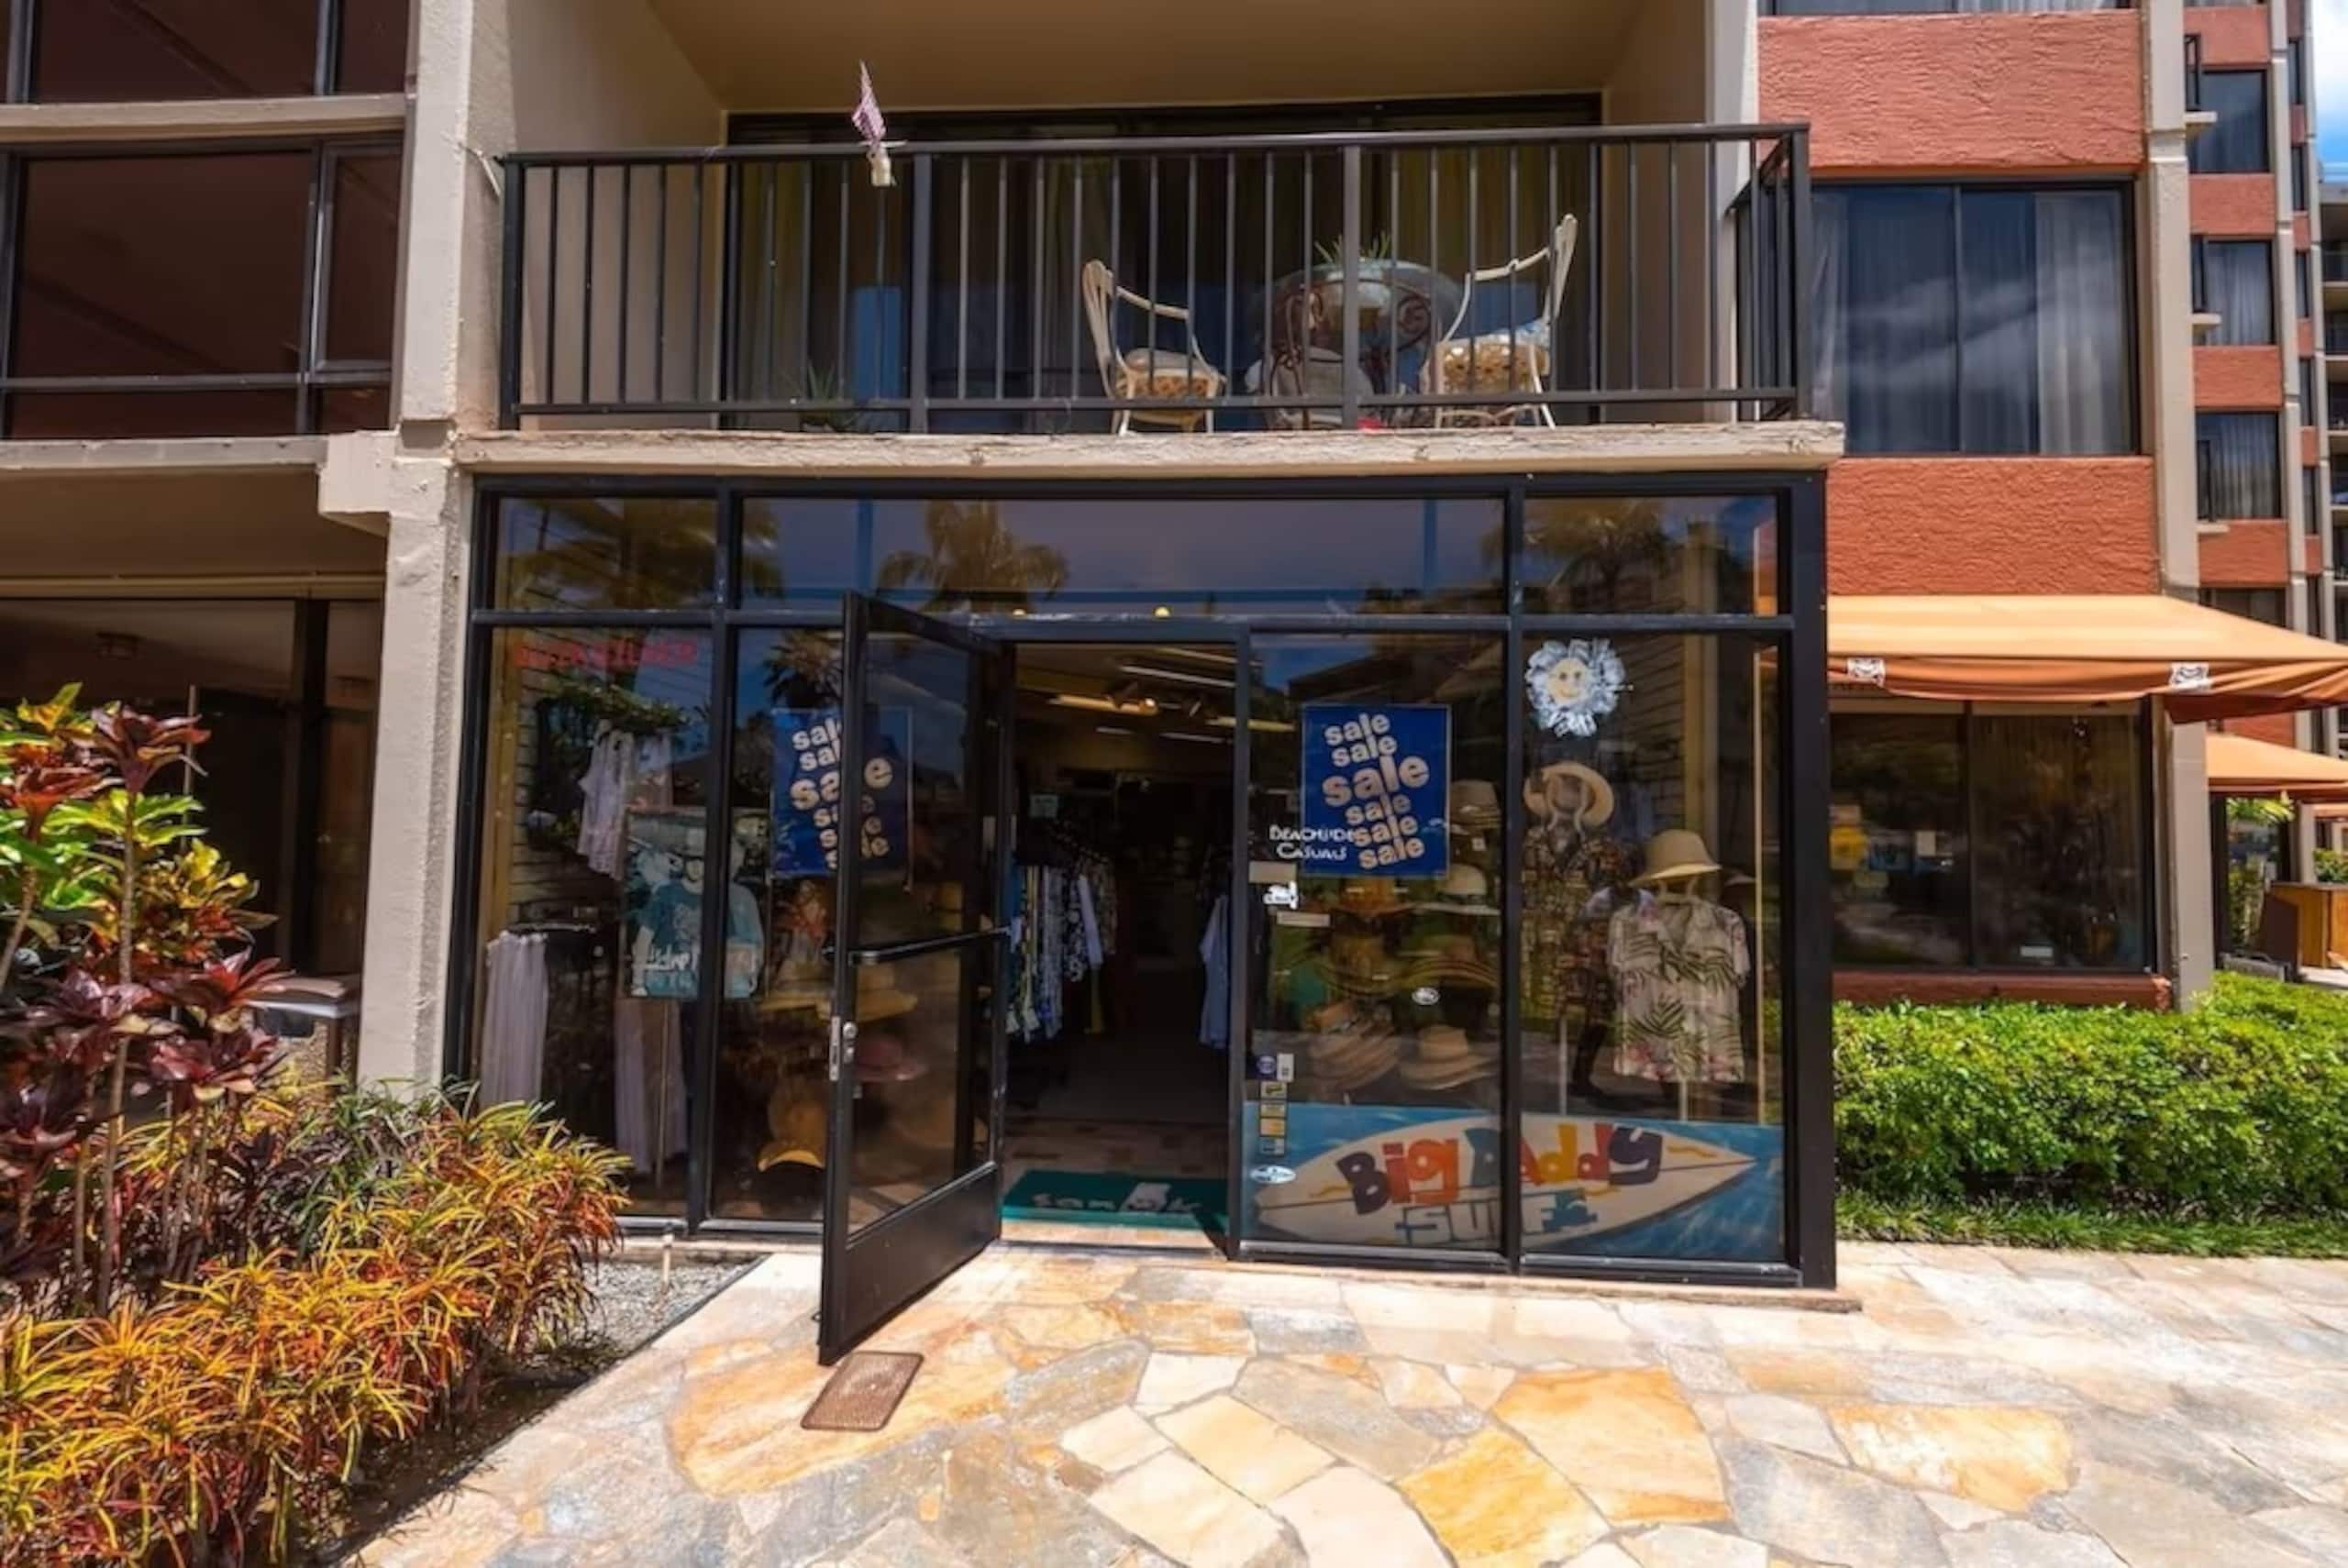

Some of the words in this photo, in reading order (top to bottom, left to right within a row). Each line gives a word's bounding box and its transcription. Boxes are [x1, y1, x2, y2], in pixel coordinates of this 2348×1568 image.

[792, 718, 843, 751] sal
[1324, 712, 1390, 745] sale
[799, 738, 841, 771] sal
[1332, 734, 1398, 767] sale
[791, 757, 893, 810] sae
[1322, 754, 1430, 807] sale
[1345, 793, 1412, 825] sale
[1352, 815, 1419, 847] sale
[1358, 838, 1424, 869] sale
[1335, 1140, 1459, 1215] Big
